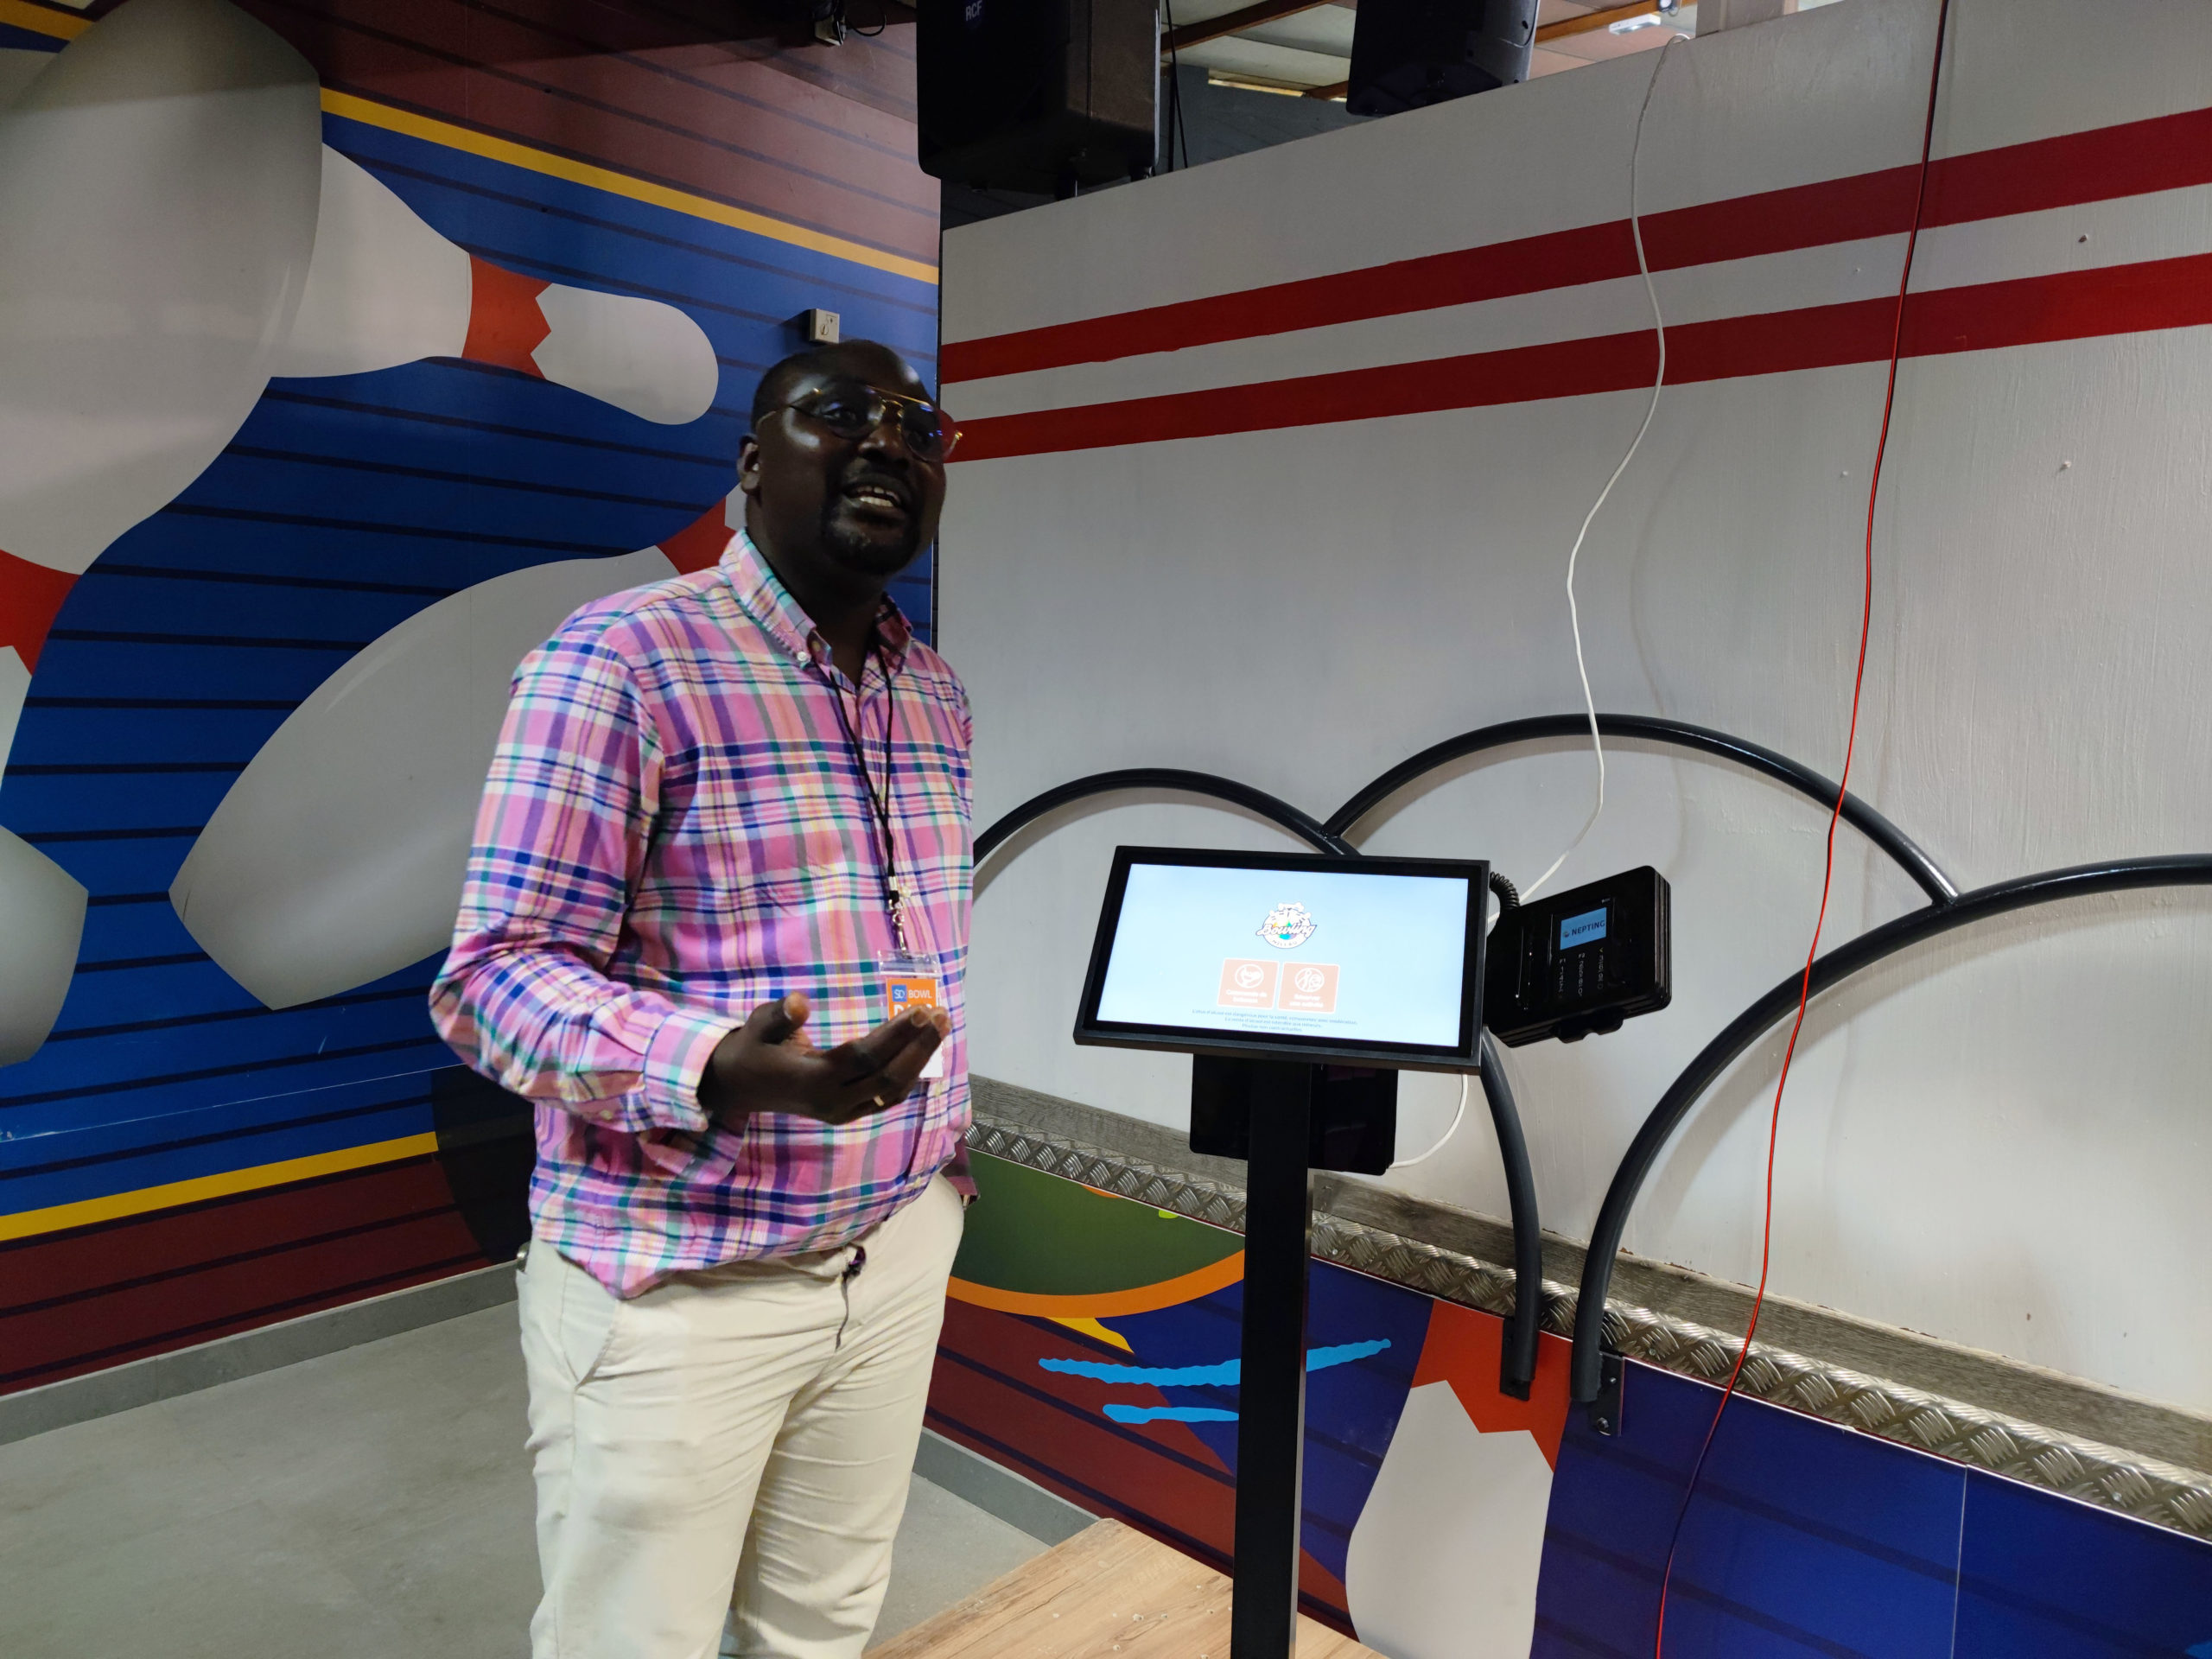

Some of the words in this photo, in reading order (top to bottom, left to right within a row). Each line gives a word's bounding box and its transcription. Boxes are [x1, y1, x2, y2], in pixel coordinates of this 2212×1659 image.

[965, 0, 982, 22] RCF
[1255, 922, 1317, 939] Bowling
[1571, 919, 1605, 936] NEPTING
[908, 988, 933, 999] BOWL
